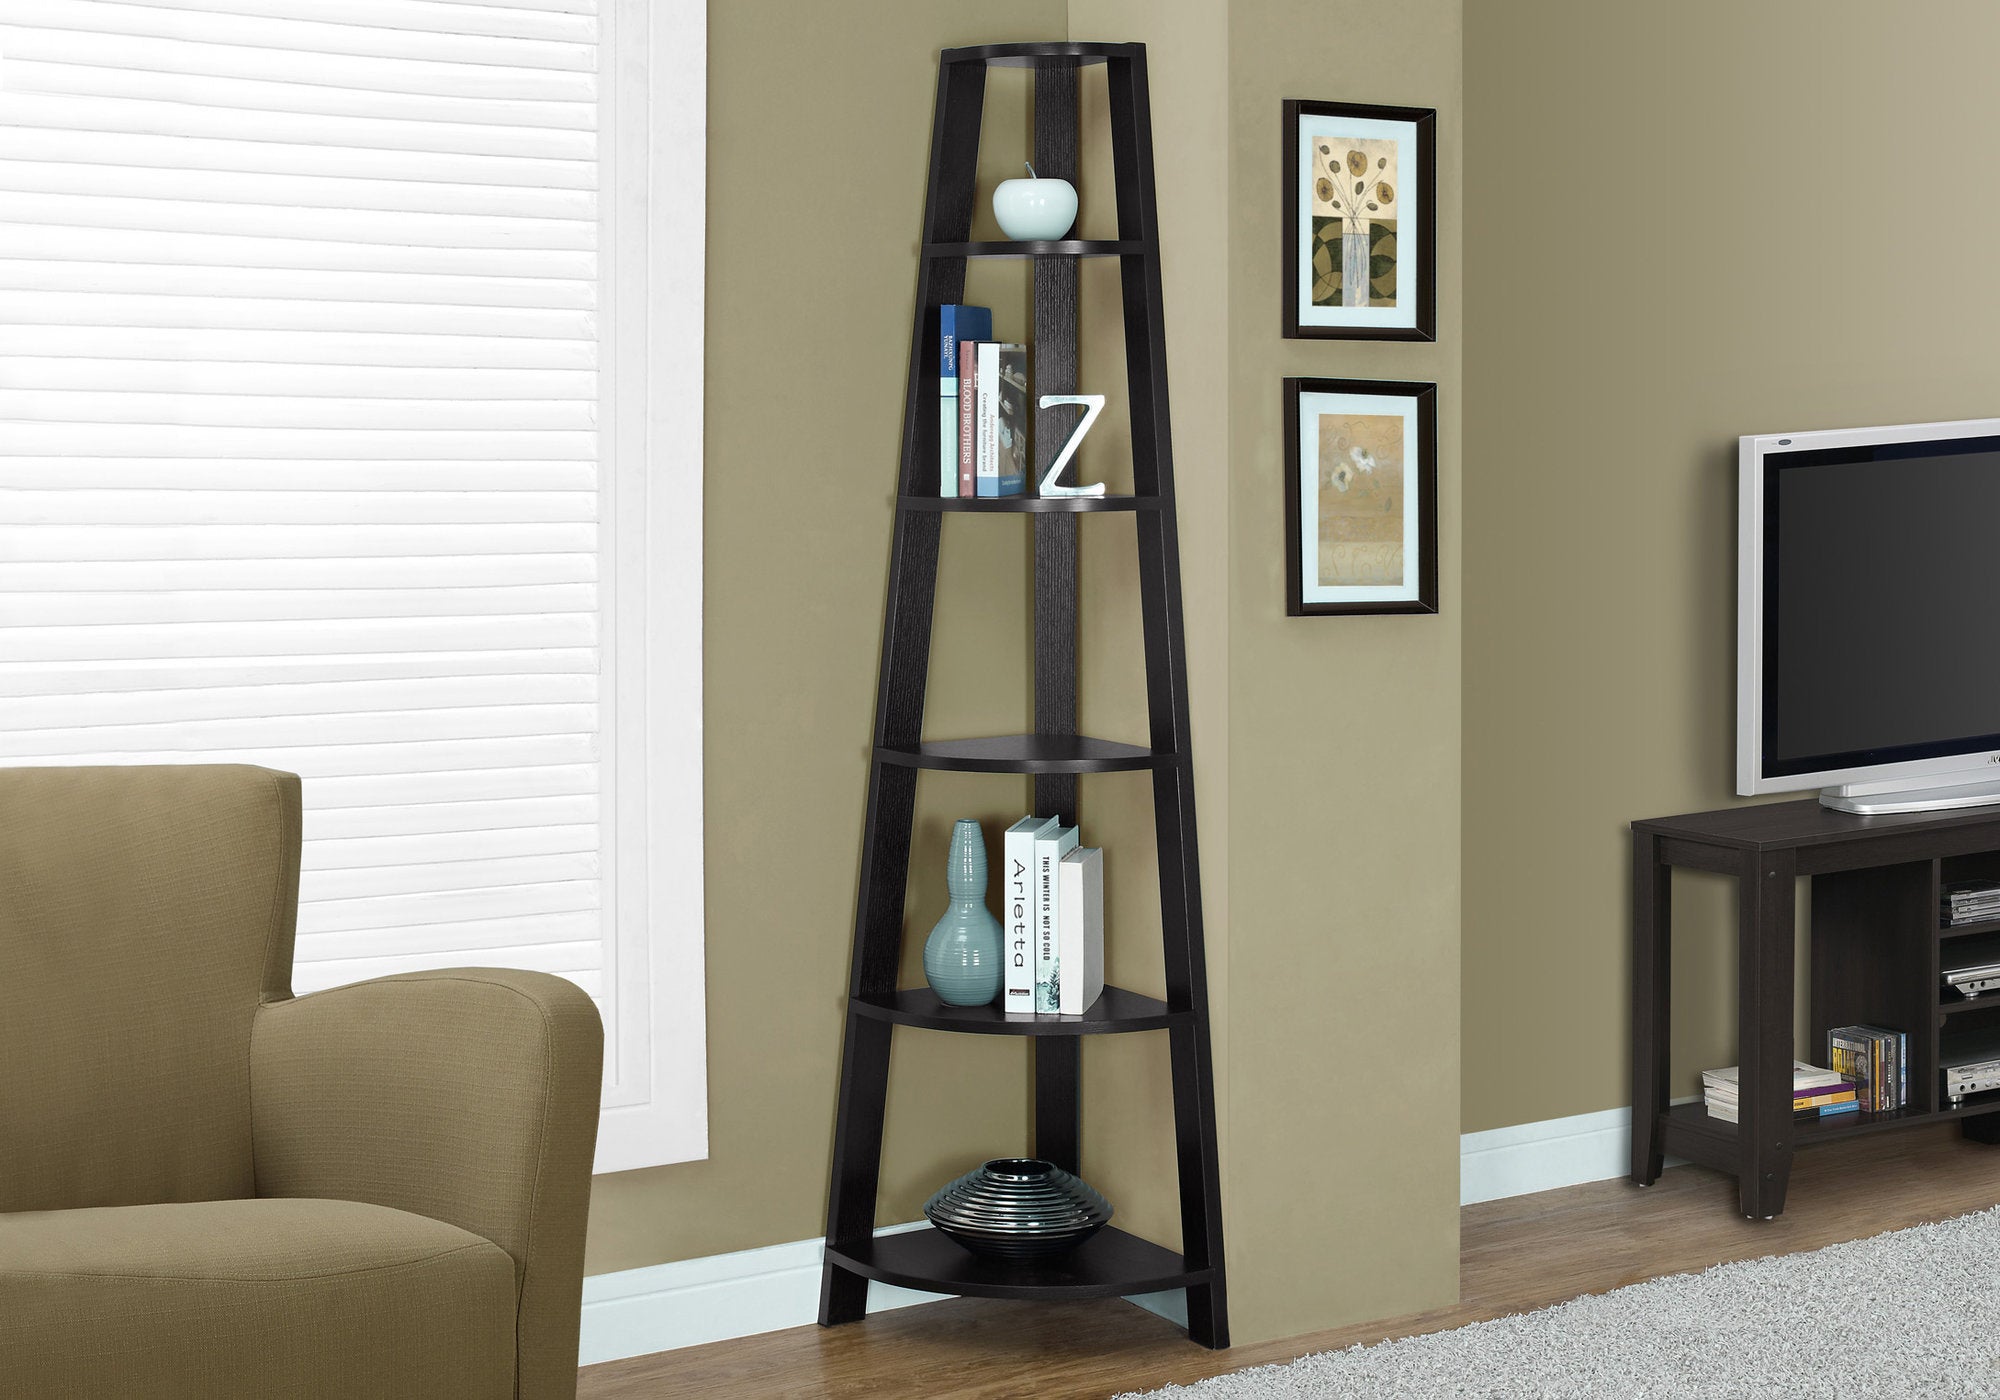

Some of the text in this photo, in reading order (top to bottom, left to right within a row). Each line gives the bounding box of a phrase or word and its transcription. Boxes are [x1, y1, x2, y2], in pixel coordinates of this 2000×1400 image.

[963, 378, 972, 411] BLOOD
[963, 413, 972, 464] BROTHERS
[1039, 395, 1106, 498] Z
[1013, 859, 1026, 968] Arletta
[1043, 903, 1050, 911] IS
[1043, 931, 1050, 941] SO
